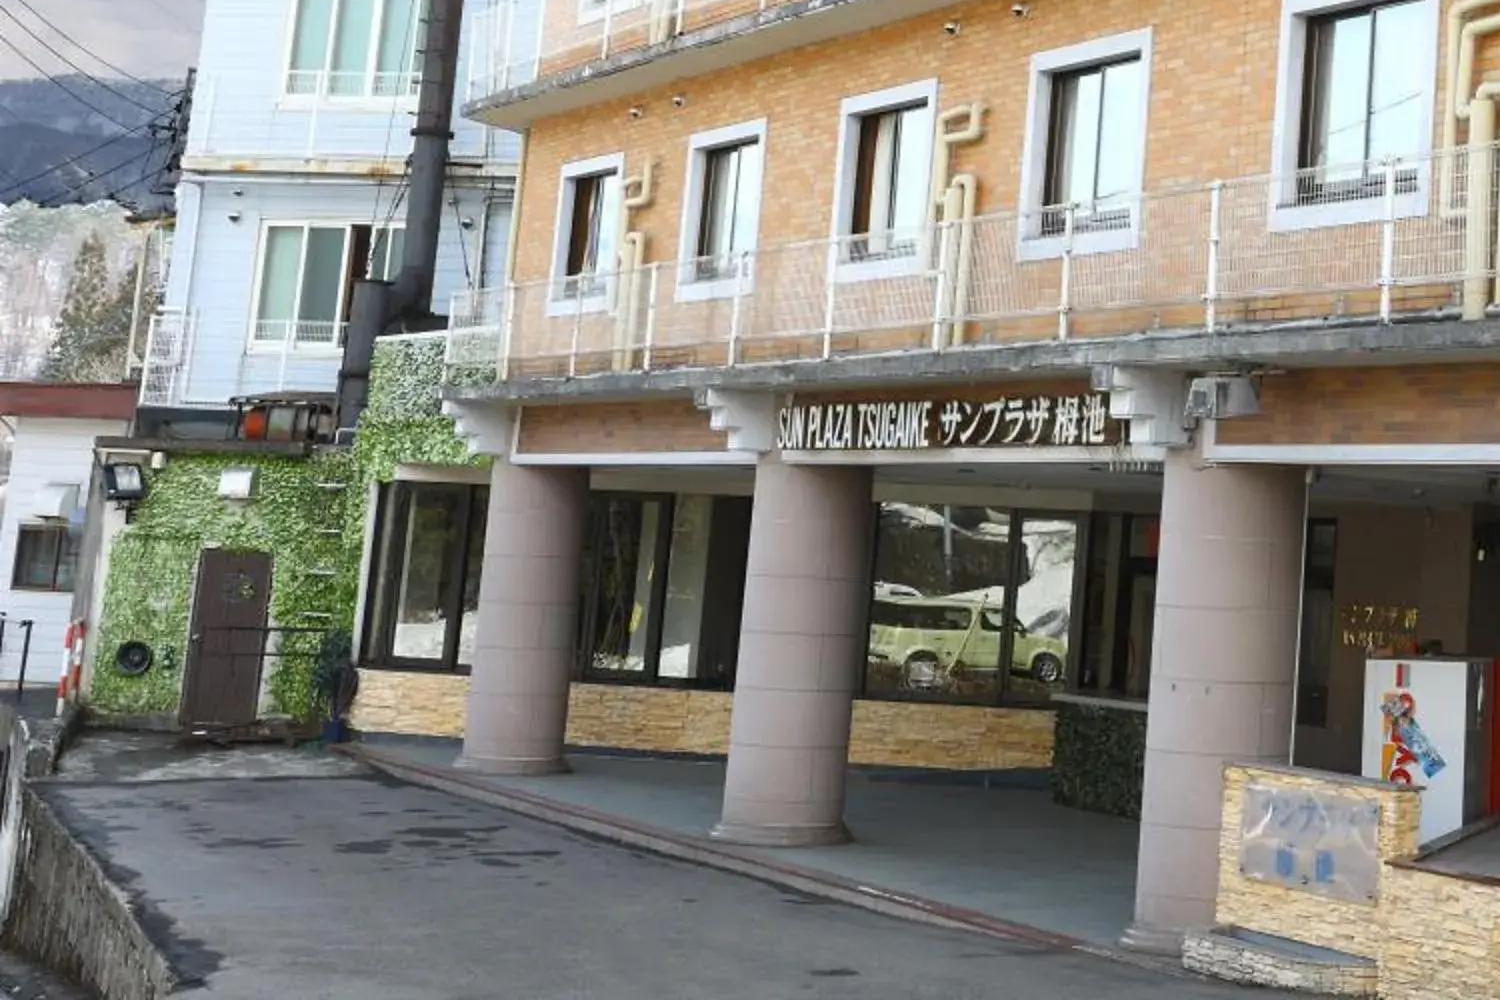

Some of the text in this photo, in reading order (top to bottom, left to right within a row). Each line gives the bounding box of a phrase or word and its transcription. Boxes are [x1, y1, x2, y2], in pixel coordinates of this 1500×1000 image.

[777, 401, 933, 449] SUN PLAZA TSUGAIKE
